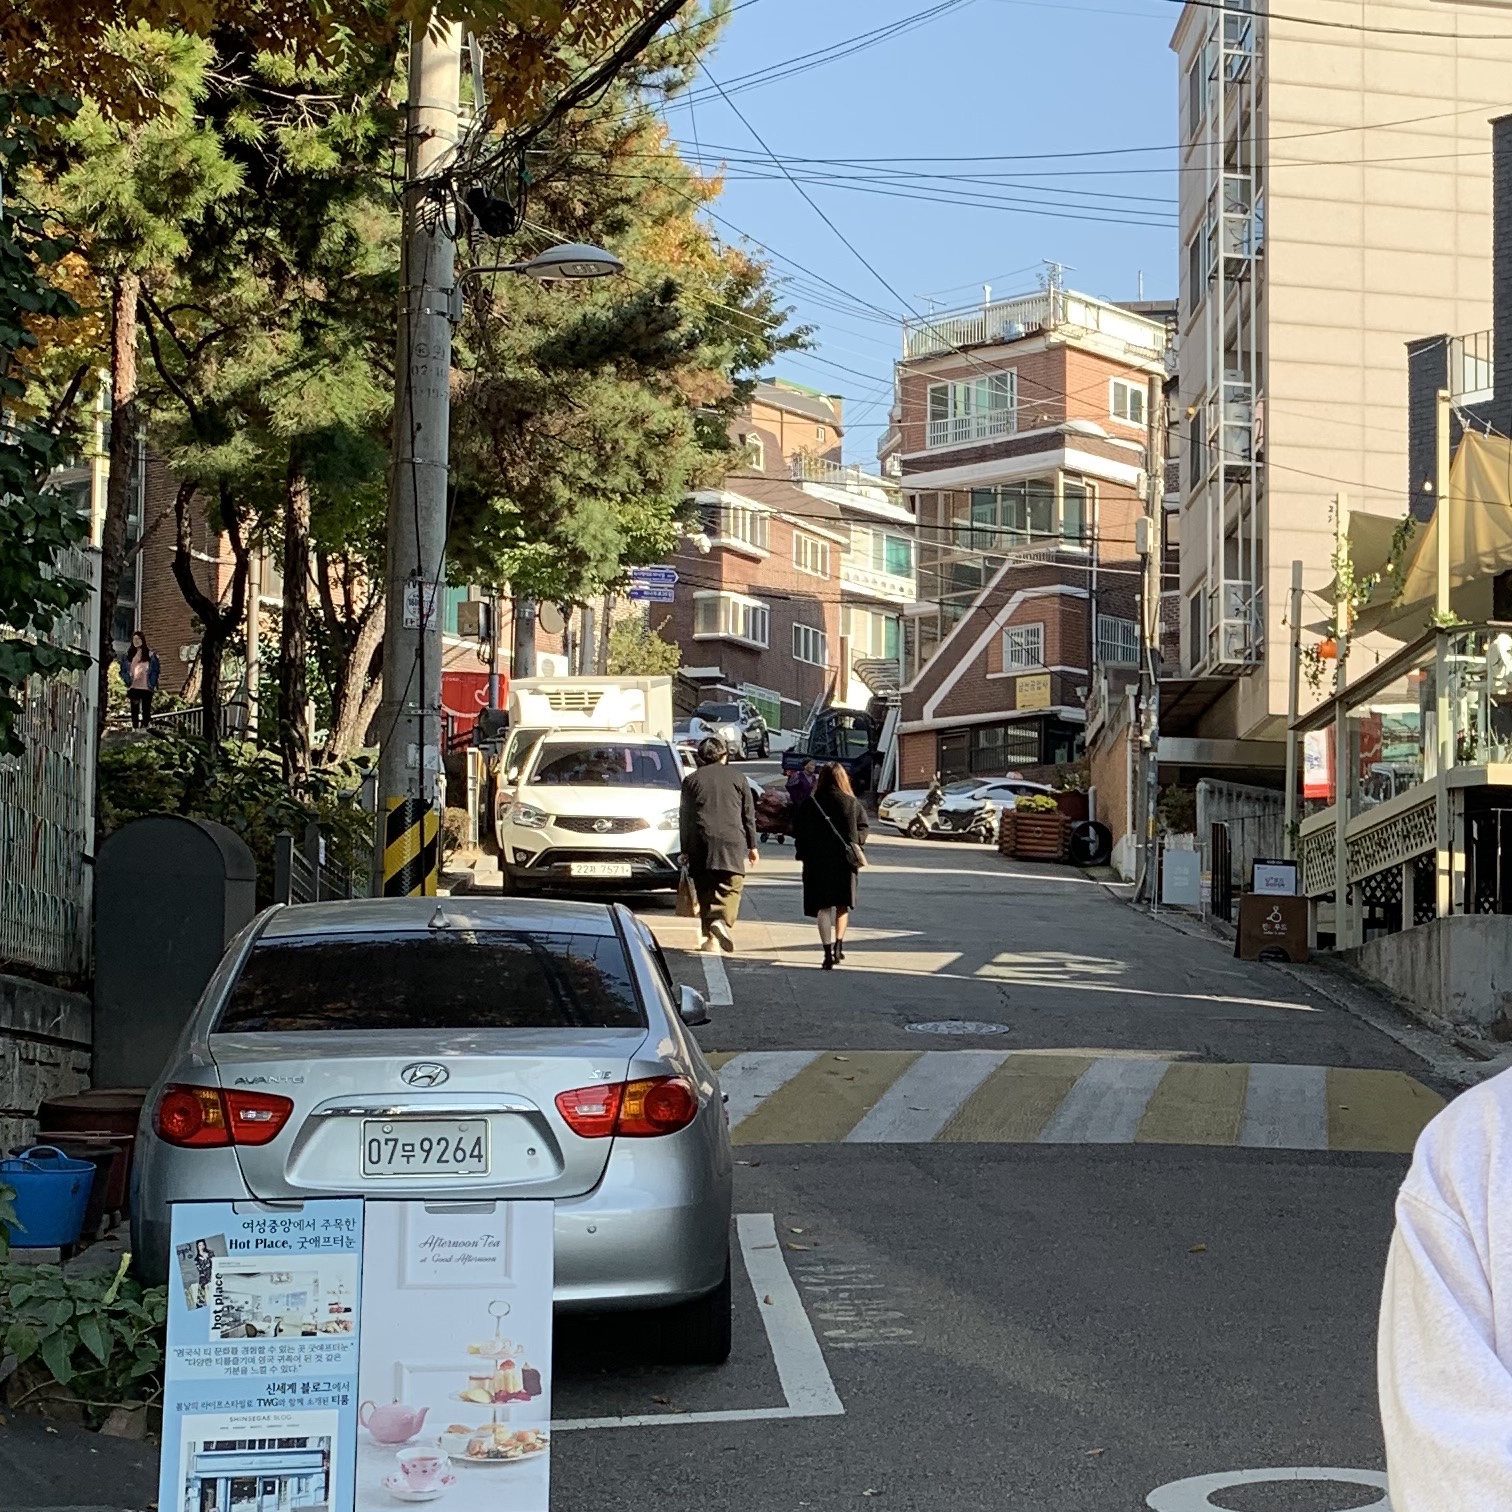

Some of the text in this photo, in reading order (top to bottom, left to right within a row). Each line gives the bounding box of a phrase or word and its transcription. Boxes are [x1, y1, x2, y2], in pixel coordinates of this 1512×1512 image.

[600, 865, 625, 875] 7571
[242, 1217, 356, 1234] 여성중앙에서 주목한
[229, 1235, 356, 1250] Hot Place, 굿애프터눈
[418, 1234, 500, 1252] Afternoon Tea
[212, 1273, 225, 1307] place
[266, 1381, 350, 1395] 신세계 블로그에서
